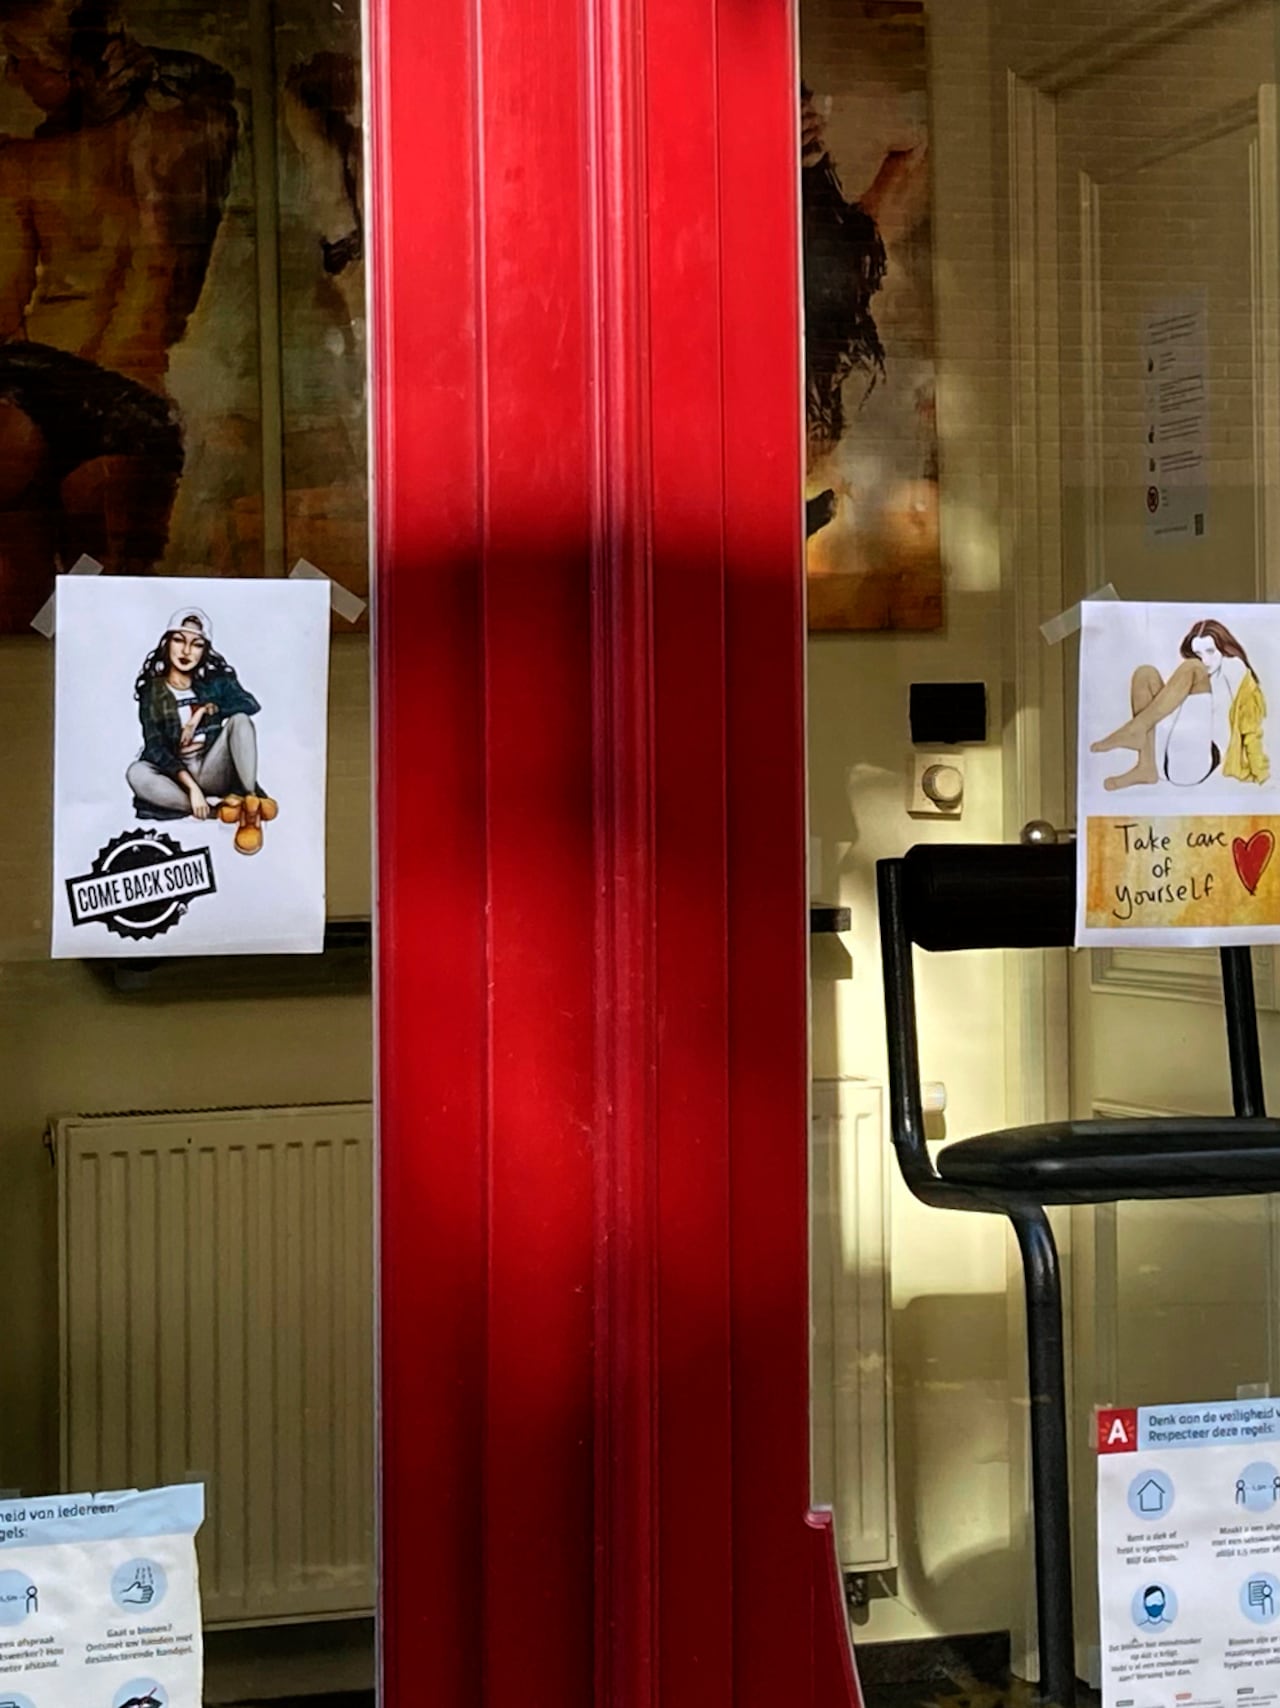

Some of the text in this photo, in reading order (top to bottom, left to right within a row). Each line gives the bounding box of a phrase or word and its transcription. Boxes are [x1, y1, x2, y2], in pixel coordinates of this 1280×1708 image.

[1114, 823, 1228, 853] Take care
[1152, 857, 1172, 878] of
[77, 859, 205, 912] COME BACK SOON
[1149, 1415, 1176, 1427] Denk
[1179, 1414, 1199, 1424] aan
[1203, 1412, 1217, 1423] de
[1219, 1407, 1274, 1422] veiligheid
[1149, 1422, 1275, 1443] Respecteer deze regels:
[29, 1509, 54, 1520] van
[58, 1503, 118, 1518] iedereen.
